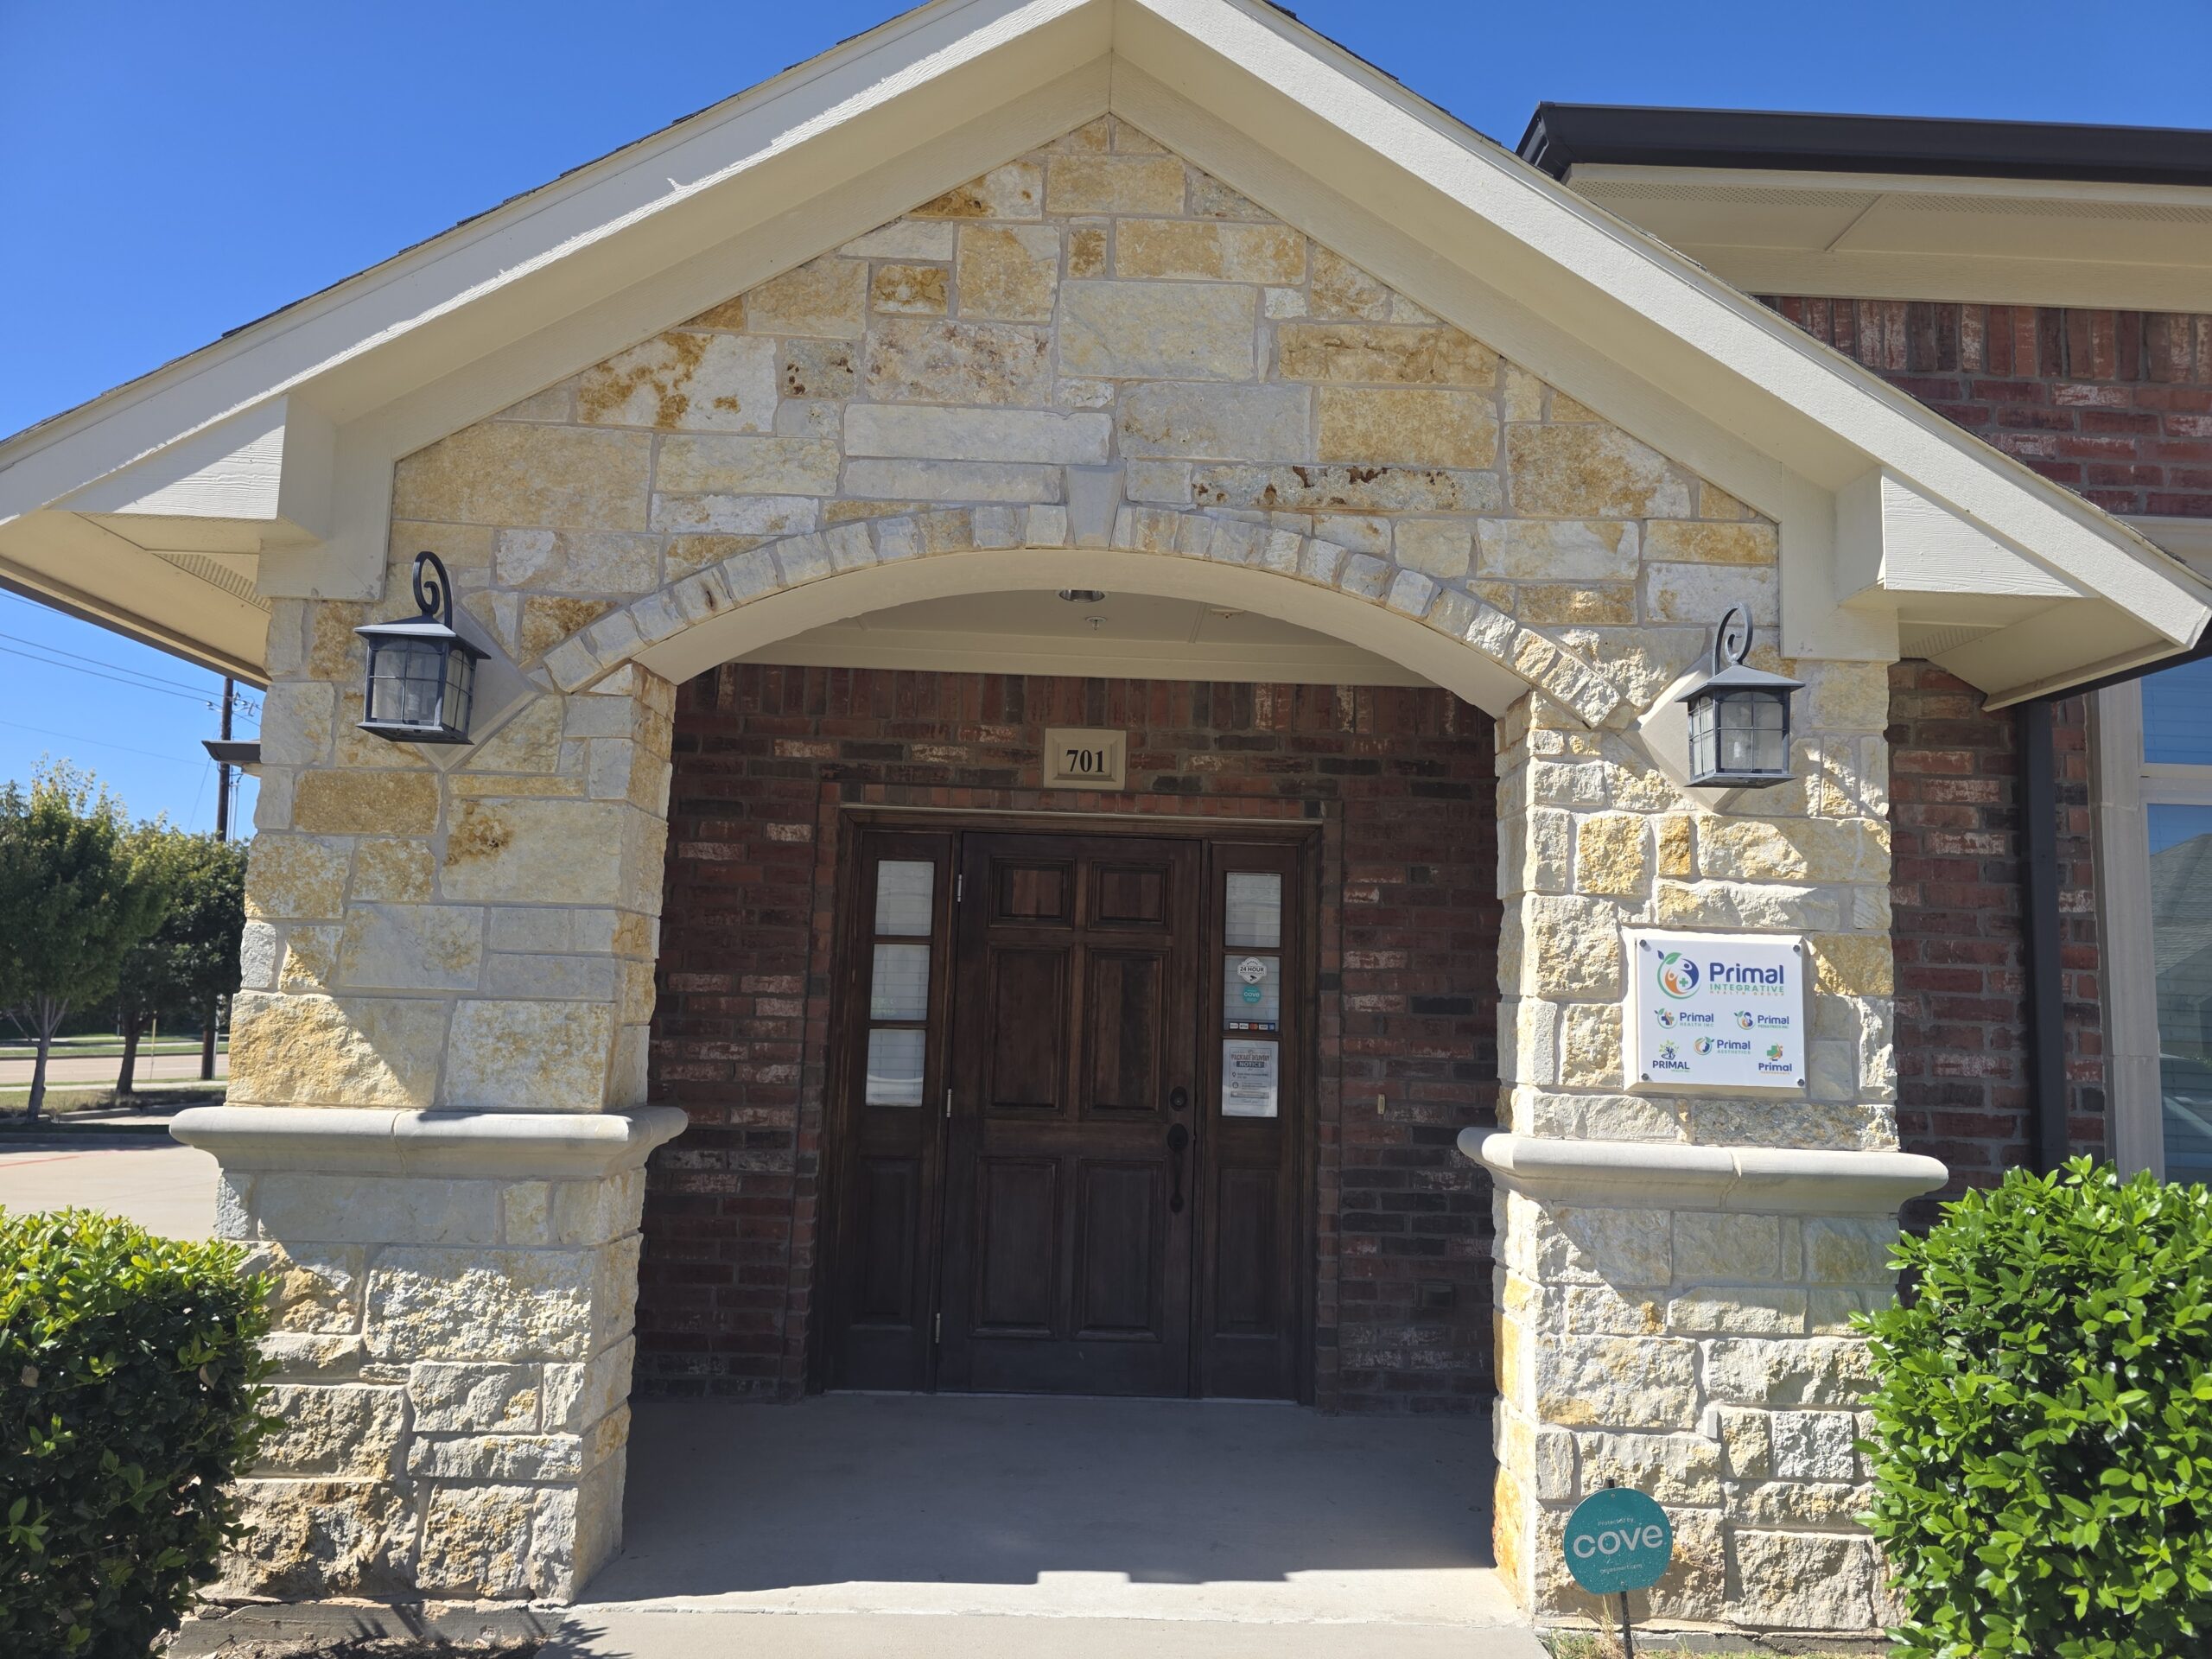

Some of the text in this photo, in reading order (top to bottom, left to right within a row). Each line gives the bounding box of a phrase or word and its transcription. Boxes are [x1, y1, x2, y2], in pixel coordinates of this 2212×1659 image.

[1066, 749, 1105, 772] 701
[1709, 962, 1784, 984] Primal
[1709, 983, 1784, 993] INTEGRATIVE
[1679, 1012, 1714, 1023] Primal
[1758, 1014, 1789, 1026] Primal
[1717, 1039, 1751, 1050] Primal
[1652, 1060, 1690, 1070] PRIMAL
[1758, 1062, 1793, 1072] Primal
[1598, 1517, 1626, 1527] Protected
[1573, 1524, 1663, 1559] cove
